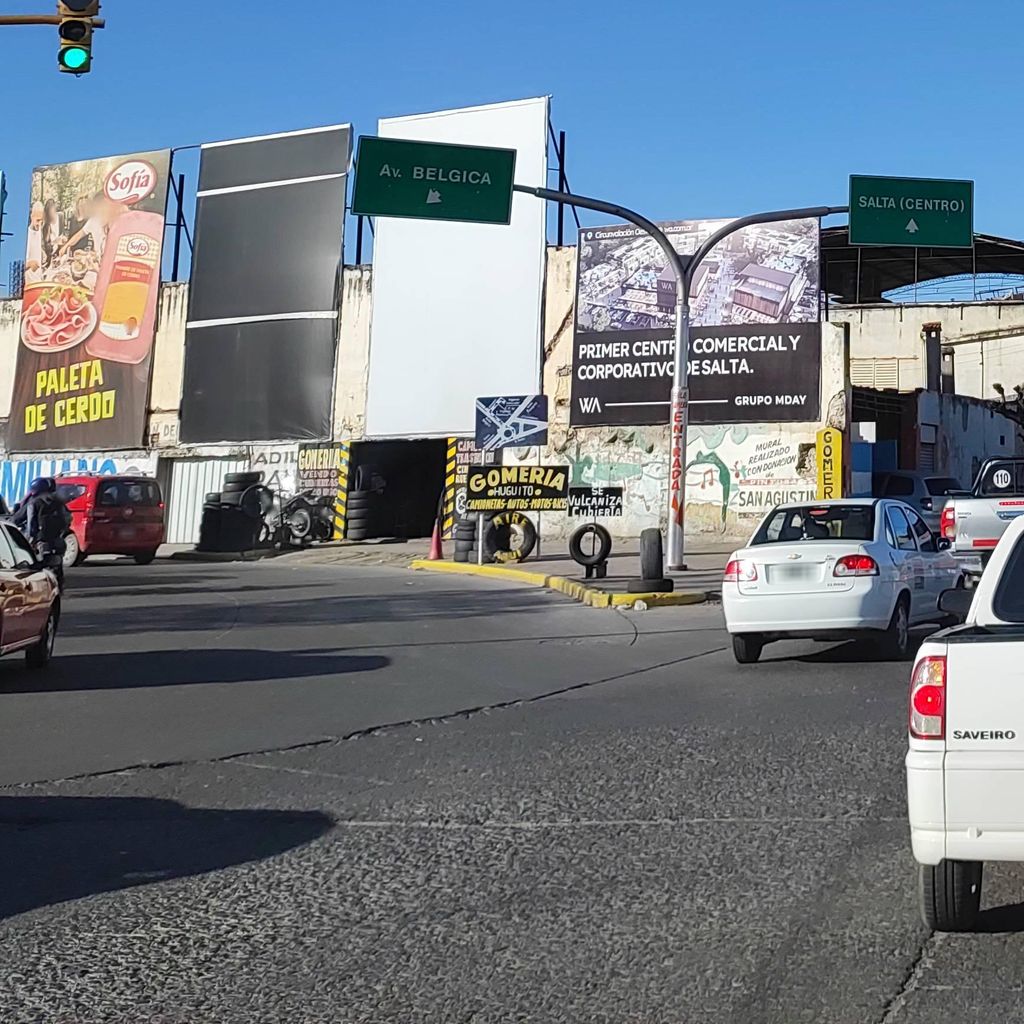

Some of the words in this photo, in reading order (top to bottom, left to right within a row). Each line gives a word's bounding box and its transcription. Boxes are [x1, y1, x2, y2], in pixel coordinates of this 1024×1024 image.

[110, 168, 150, 194] Sofía
[379, 164, 402, 178] Av.
[412, 166, 492, 185] BELGICA
[858, 196, 896, 209] SALTA
[900, 197, 965, 213] (CENTRO)
[579, 343, 630, 360] PRIMER
[632, 339, 690, 357] CENTR
[693, 336, 786, 355] COMERCIAL
[788, 335, 801, 351] Y
[702, 359, 754, 376] SALTA.
[36, 359, 104, 398] PALETA
[735, 395, 773, 406] GRUPO
[775, 394, 807, 405] MDAY
[24, 403, 47, 434] DE
[54, 389, 117, 428] CERDO
[671, 411, 683, 491] ENTRADA
[755, 438, 783, 452] MURAL
[299, 448, 341, 470] GOMERIA
[748, 446, 791, 465] REALIZADO
[469, 464, 565, 492] GOMERIA
[747, 464, 763, 477] CON
[995, 472, 1010, 485] 110
[493, 485, 534, 496] HUGUITO
[591, 487, 604, 496] SE
[738, 491, 763, 507] SAN
[953, 729, 1016, 740] SAVEIRO
